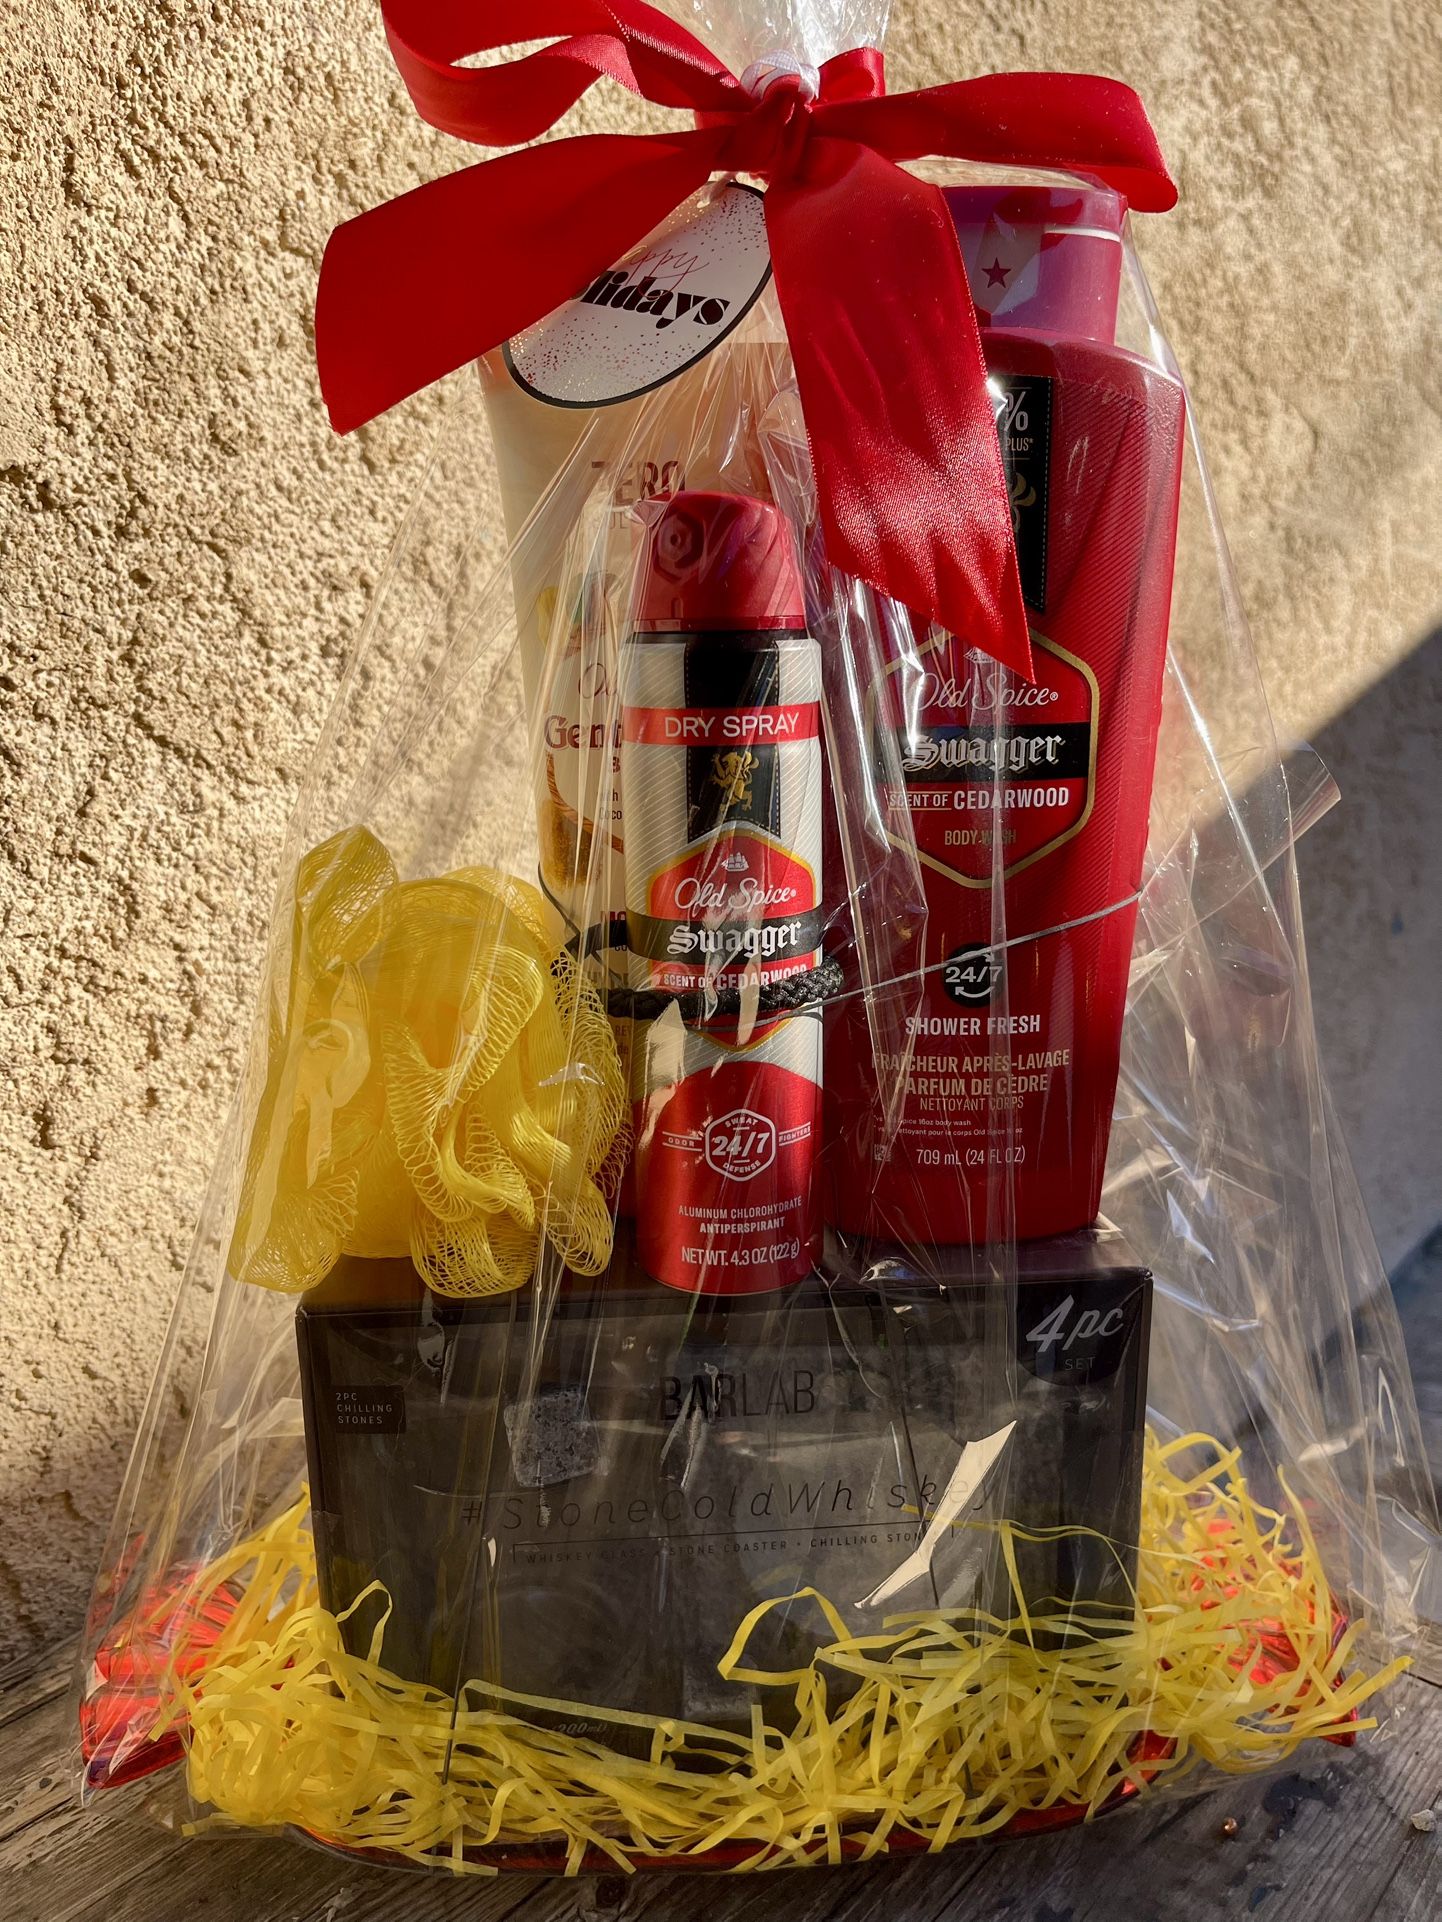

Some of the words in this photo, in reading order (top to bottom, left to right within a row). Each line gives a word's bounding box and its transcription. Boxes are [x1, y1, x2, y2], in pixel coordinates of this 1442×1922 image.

[580, 270, 731, 330] lidays
[665, 716, 714, 738] DRY
[723, 712, 799, 738] SPRAY
[901, 734, 1067, 774] Swagger
[889, 793, 929, 808] SCENT
[932, 793, 949, 807] OF
[953, 787, 1070, 810] CEDARWOOD
[944, 829, 978, 846] BODY
[981, 828, 1017, 846] WSH
[674, 877, 728, 917] Old
[666, 920, 802, 959] Swagger
[663, 974, 696, 988] SCENT
[698, 976, 713, 988] OF
[945, 965, 1003, 983] 24/7
[905, 1016, 981, 1036] SHOWER
[987, 1014, 1041, 1035] FRESH
[971, 1078, 991, 1096] DE
[996, 1073, 1049, 1095] CÈDRE
[919, 1097, 985, 1112] NETTOYANT
[990, 1095, 1025, 1110] CORPS
[725, 1116, 759, 1129] SWEAT
[935, 1119, 952, 1128] body
[954, 1119, 972, 1127] wash
[668, 1137, 695, 1147] ODOR
[711, 1131, 771, 1158] 24/7
[722, 1159, 762, 1174] DEFENSE
[916, 1149, 940, 1165] 709
[944, 1149, 962, 1166] mL
[965, 1147, 985, 1167] (24
[989, 1148, 1002, 1164] FL
[1005, 1144, 1026, 1164] OZ)
[678, 1204, 728, 1219] ALUMINUM
[730, 1195, 803, 1219] CHLOROHYDRATE
[699, 1216, 786, 1234] ANTIPERSPIRANT
[681, 1246, 705, 1265] NET
[705, 1249, 729, 1267] WT.
[730, 1249, 750, 1266] 4.3
[751, 1248, 768, 1265] OZ
[769, 1244, 790, 1264] (122
[1064, 1356, 1097, 1371] SET
[335, 1392, 358, 1401] 2PC
[660, 1369, 816, 1421] BARLAB
[336, 1404, 393, 1413] CHILLING
[338, 1415, 383, 1425] STONES
[527, 1551, 592, 1564] WHISKEY
[668, 1544, 715, 1557] STONE
[723, 1540, 788, 1553] COASTER
[810, 1534, 878, 1548] CHILLING
[887, 1530, 932, 1543] STON
